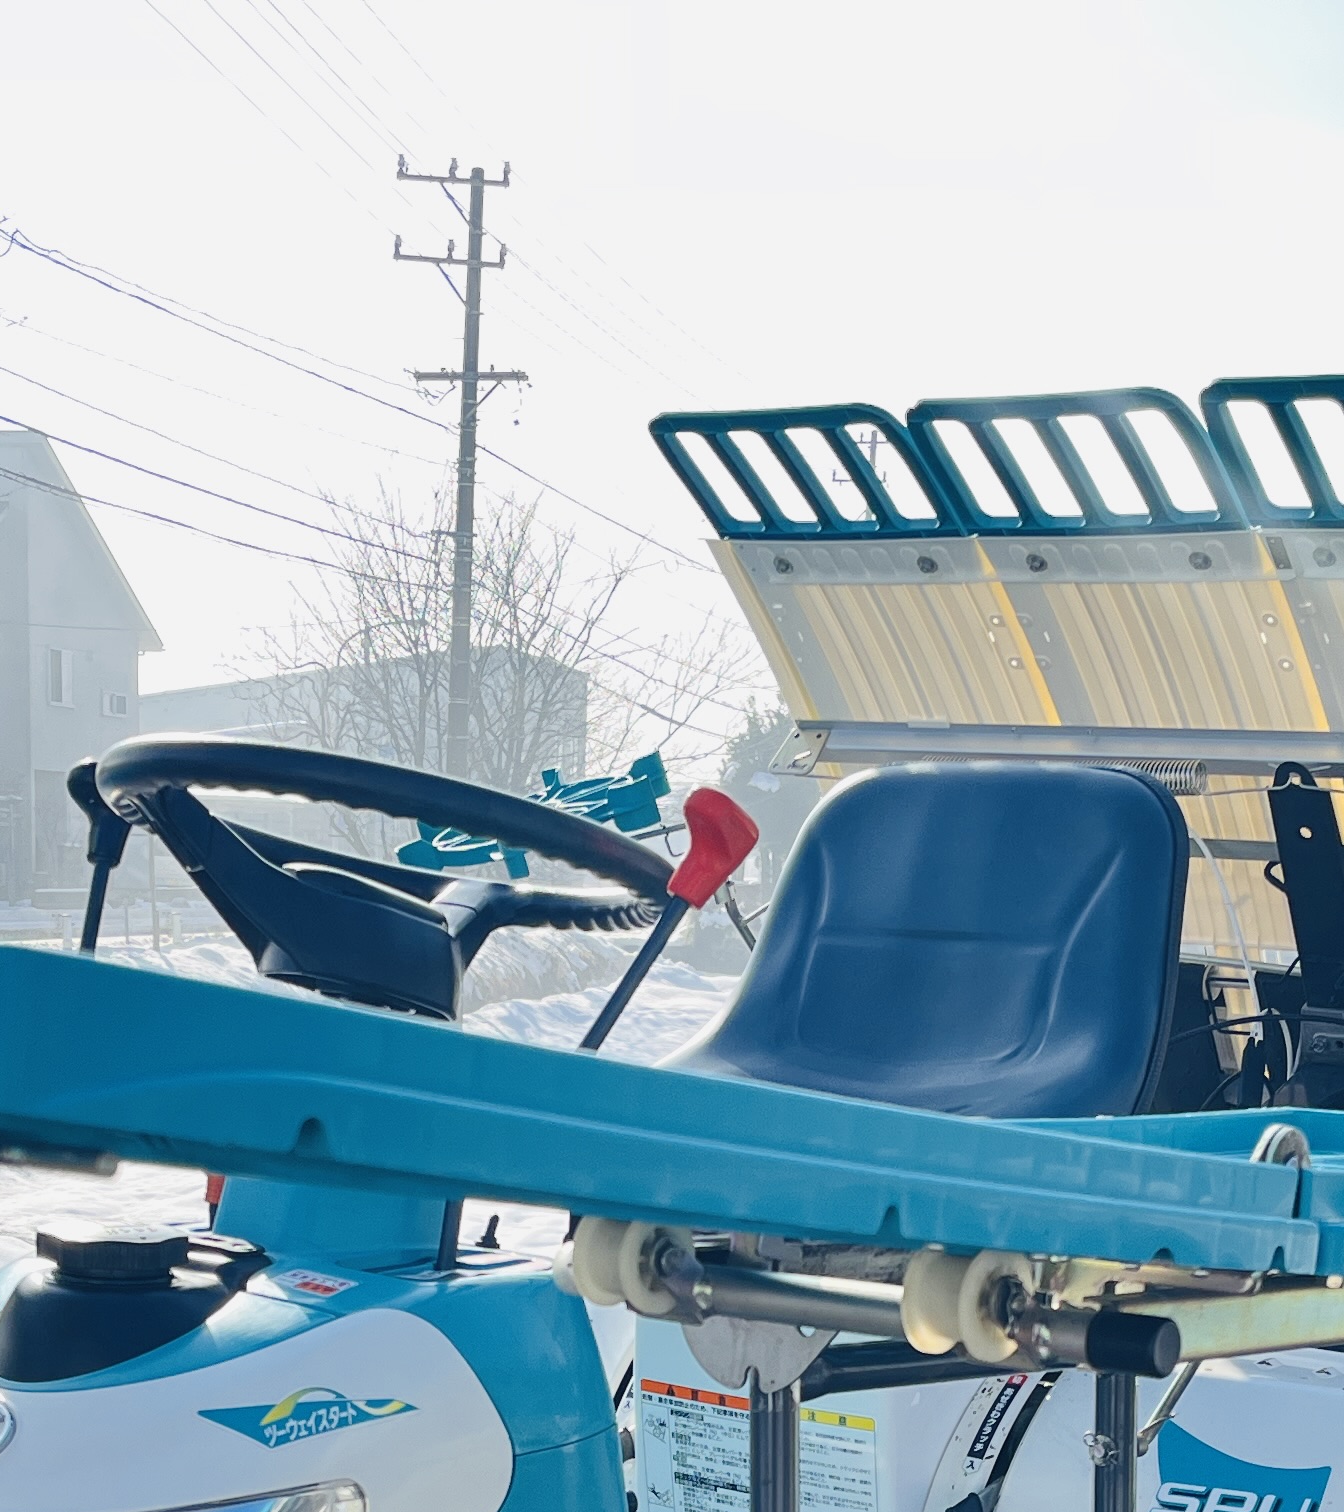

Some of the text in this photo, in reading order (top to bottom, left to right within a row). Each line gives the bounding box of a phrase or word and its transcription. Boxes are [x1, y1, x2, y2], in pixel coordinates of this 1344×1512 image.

[263, 1402, 357, 1447] ツーウェイスタート
